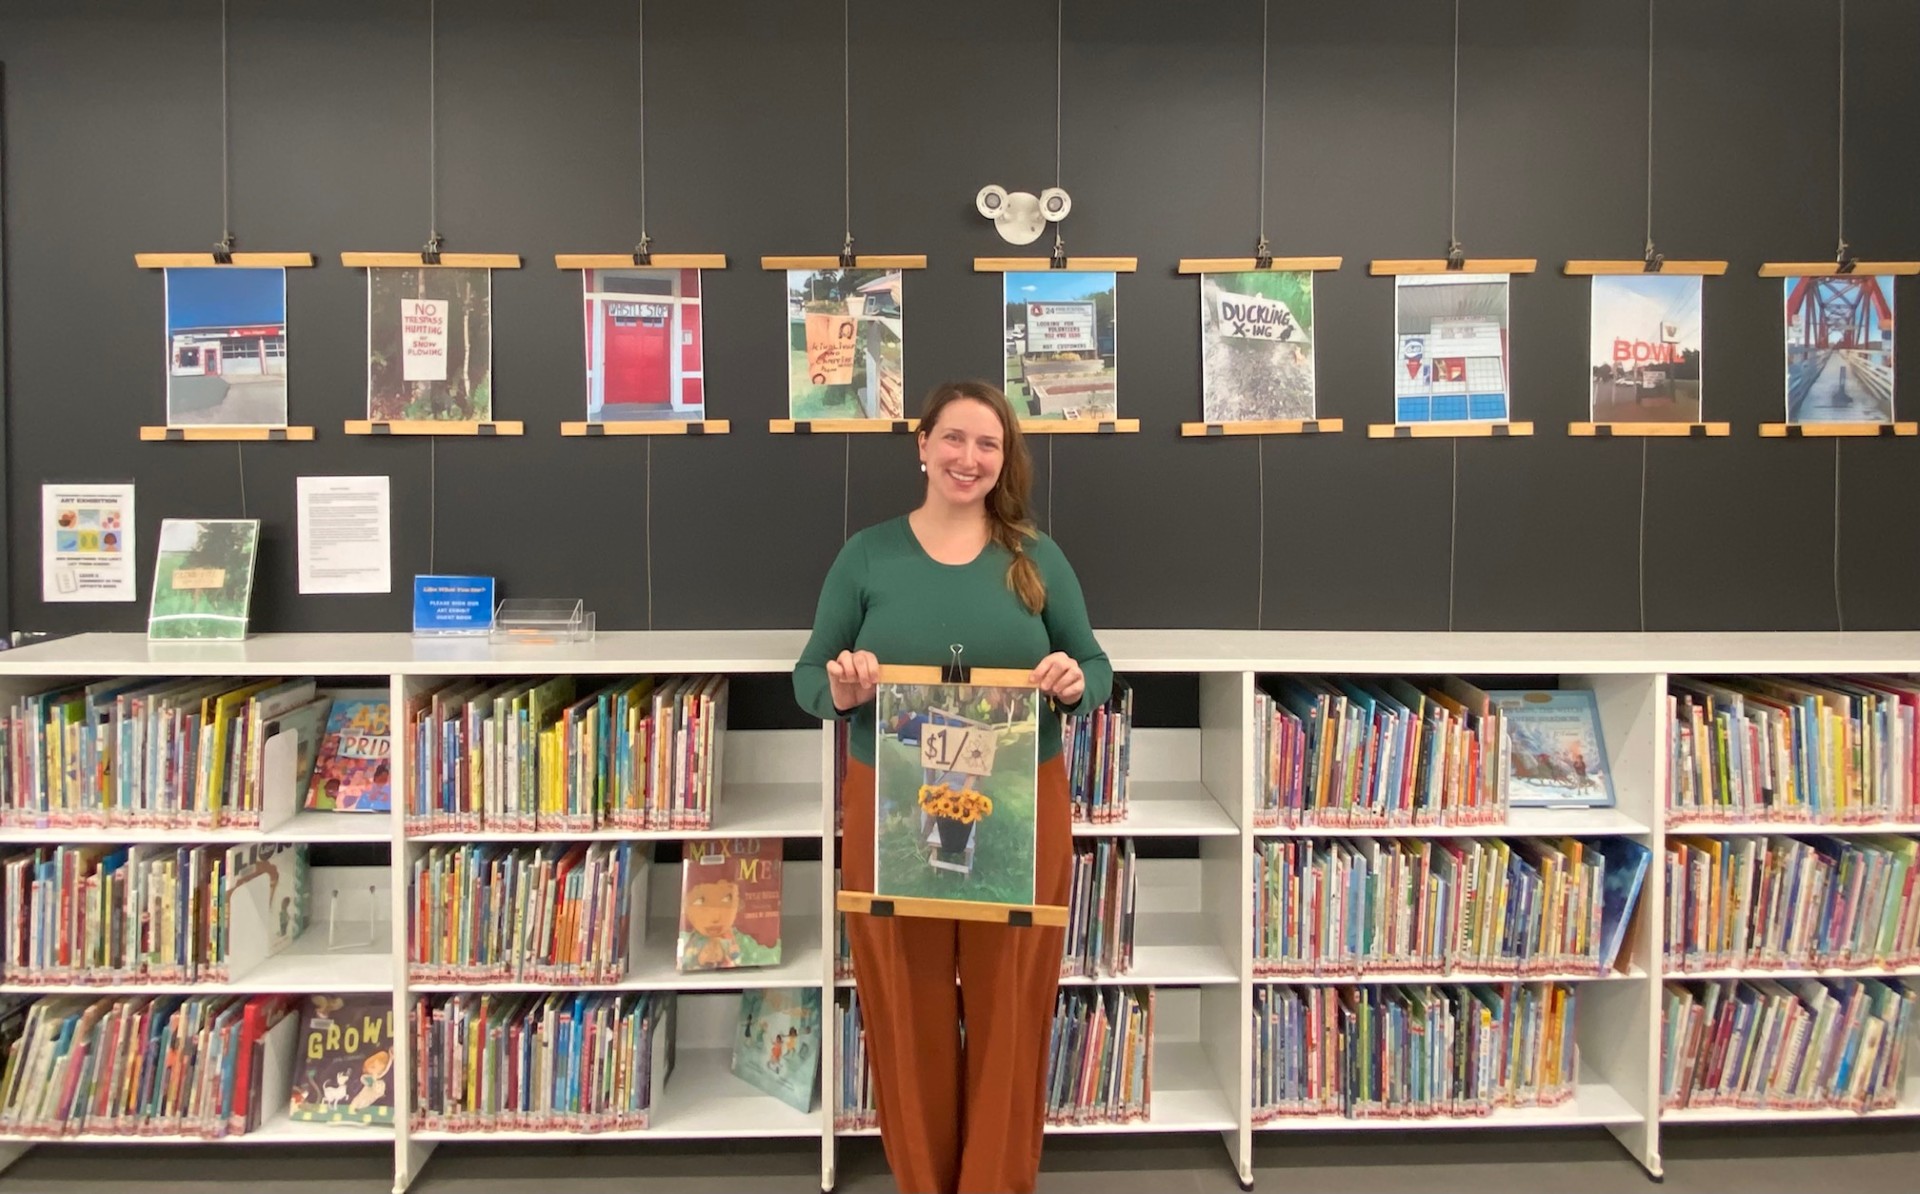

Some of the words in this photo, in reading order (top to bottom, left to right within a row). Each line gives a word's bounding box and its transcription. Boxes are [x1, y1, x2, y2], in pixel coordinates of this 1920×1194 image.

[415, 304, 436, 316] NO
[647, 304, 668, 316] STOP
[405, 316, 442, 324] TRESPASS
[405, 325, 442, 335] HUNTING
[1232, 321, 1272, 337] X-ING
[1613, 340, 1685, 364] BOWL
[689, 838, 760, 861] MIXED
[738, 859, 772, 883] ME
[308, 1011, 393, 1059] GROWL
